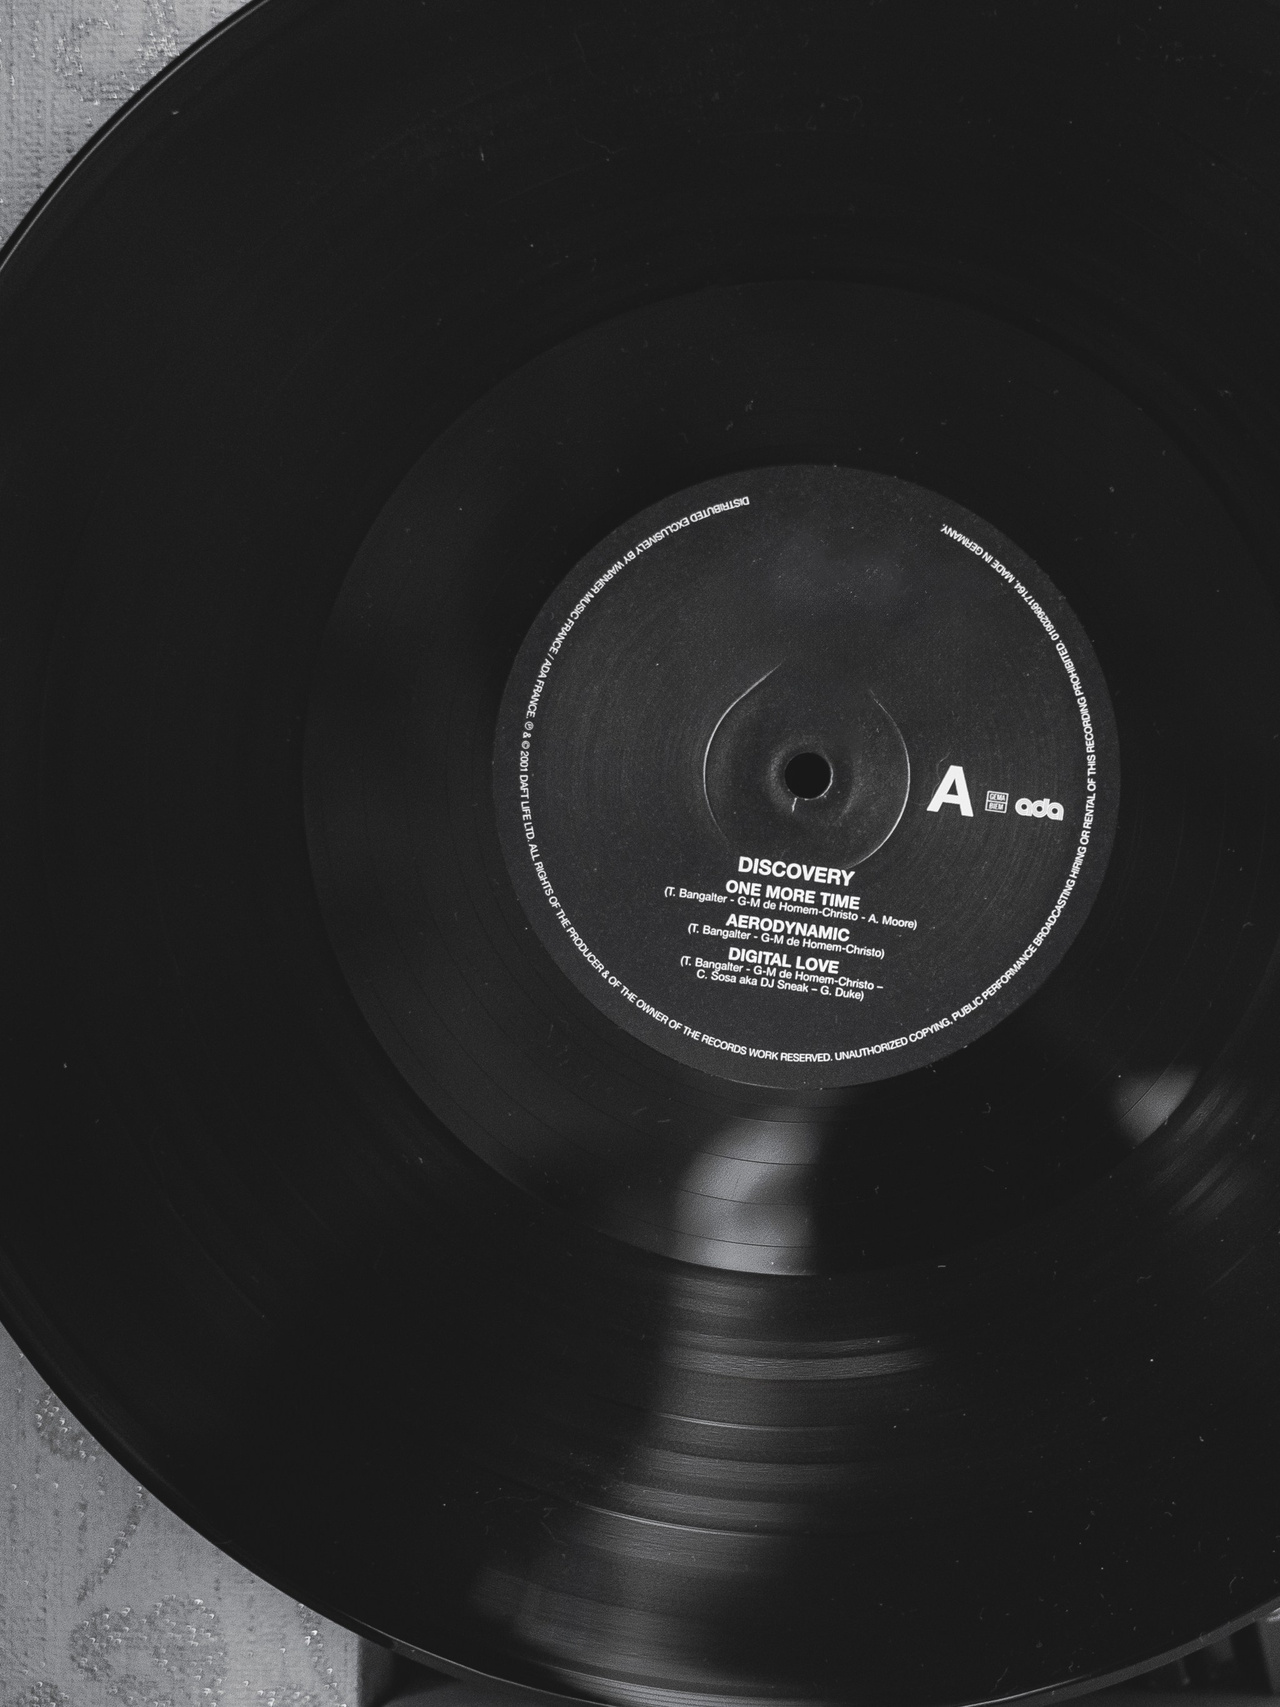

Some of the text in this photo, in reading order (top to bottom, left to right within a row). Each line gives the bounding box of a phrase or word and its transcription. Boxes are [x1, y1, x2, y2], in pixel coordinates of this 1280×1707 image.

[689, 495, 750, 523] DISTRIBUTED
[635, 516, 690, 555] EXCLUSIVELY
[939, 523, 984, 556] GERMANY.
[622, 550, 636, 564] BY
[981, 551, 994, 563] IN
[989, 558, 1016, 583] MADE
[589, 560, 625, 594] WARNER
[569, 590, 595, 620] MUSIC
[1013, 579, 1060, 641] 0190296617164.
[548, 617, 575, 655] FRANCE
[537, 658, 552, 678] ADA
[1055, 639, 1084, 697] PROHIBITED.
[525, 678, 545, 719] FRANCE.
[1076, 695, 1095, 753] RECORDING
[519, 750, 530, 771] 2001
[1086, 753, 1096, 776] THIS
[519, 774, 529, 799] DAFT
[927, 765, 1064, 821] A ada
[1086, 777, 1096, 792] OF
[520, 800, 532, 821] LIFE
[1082, 792, 1096, 829] RENTAL
[523, 821, 535, 842] LTD.
[1079, 829, 1091, 845] OR
[528, 843, 540, 862] ALL
[1068, 845, 1087, 879] HIRING
[533, 861, 554, 896] RIGHTS
[737, 856, 855, 886] DISCOVERY
[548, 895, 561, 908] OF
[663, 886, 917, 929] (T. Bangalter G-M de Homem-Christo A. Moore)
[725, 879, 860, 910] ONE MORE TIME
[555, 908, 571, 929] THE
[1032, 878, 1076, 947] BROADCASTING
[687, 923, 884, 959] (T. Bangalter G-M de Homem-Christo)
[725, 913, 850, 942] AERODYNAMIC
[565, 926, 605, 973] PRODUCER
[727, 946, 839, 974] DIGITAL LOVE
[600, 969, 610, 979] &
[607, 975, 622, 988] OF
[679, 955, 874, 990] (T. Bangalter G-M de Homem-Christo
[696, 969, 864, 1001] C. Sosa aka DJ Sneak G. Duke)
[980, 943, 1038, 1000] PERFORMANCE
[620, 984, 638, 1003] THE
[635, 998, 669, 1025] OWNER
[950, 995, 984, 1021] PUBLIC
[667, 1018, 683, 1030] OF
[682, 1025, 702, 1041] THE
[908, 1017, 953, 1043] COPYING,
[700, 1033, 747, 1055] RECORDS
[748, 1047, 779, 1061] WORK
[779, 1051, 833, 1062] RESERVED.
[834, 1036, 909, 1061] UNAUTHORIZED
